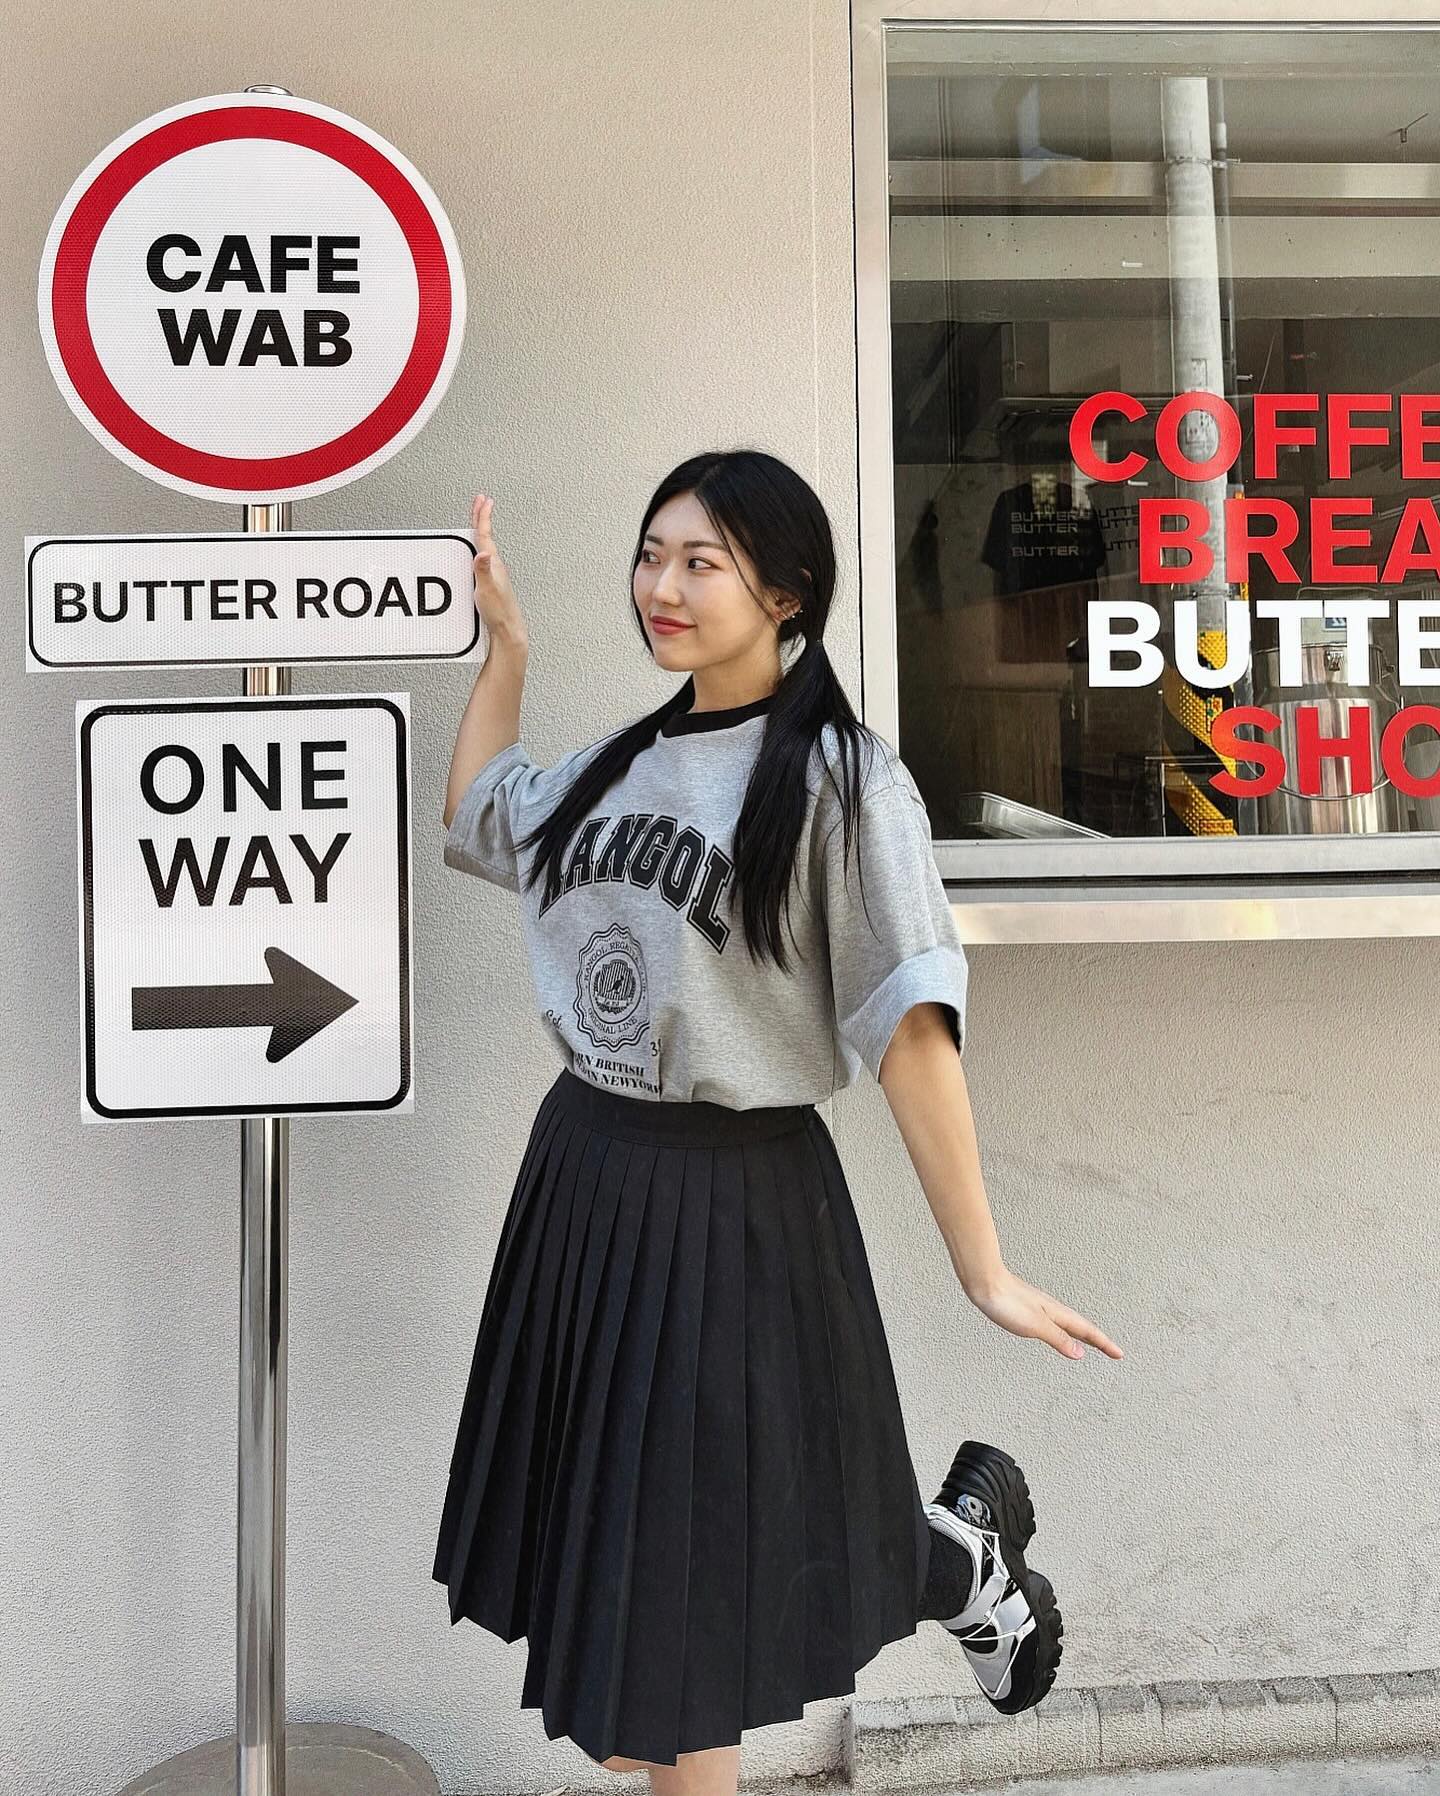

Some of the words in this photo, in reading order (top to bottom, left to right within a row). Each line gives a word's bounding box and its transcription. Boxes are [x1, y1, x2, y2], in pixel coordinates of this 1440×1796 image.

[146, 234, 361, 294] CAFE
[157, 308, 353, 368] WAB
[1068, 391, 1440, 481] COFFE
[1010, 511, 1078, 523] BUTTER
[1010, 522, 1079, 534] BUTTER
[1099, 505, 1138, 517] UTTE
[1100, 516, 1138, 529] UTTE
[1138, 497, 1440, 585] BREA
[1012, 545, 1079, 557] BUTTER
[54, 577, 279, 625] BUTTER
[296, 575, 453, 619] ROAD
[1087, 600, 1440, 688] BUTTE
[139, 740, 349, 815] ONE
[1208, 704, 1440, 799] SHO
[138, 832, 352, 908] WAY
[539, 814, 735, 955] ANGOL
[595, 1058, 644, 1077] BRITISH
